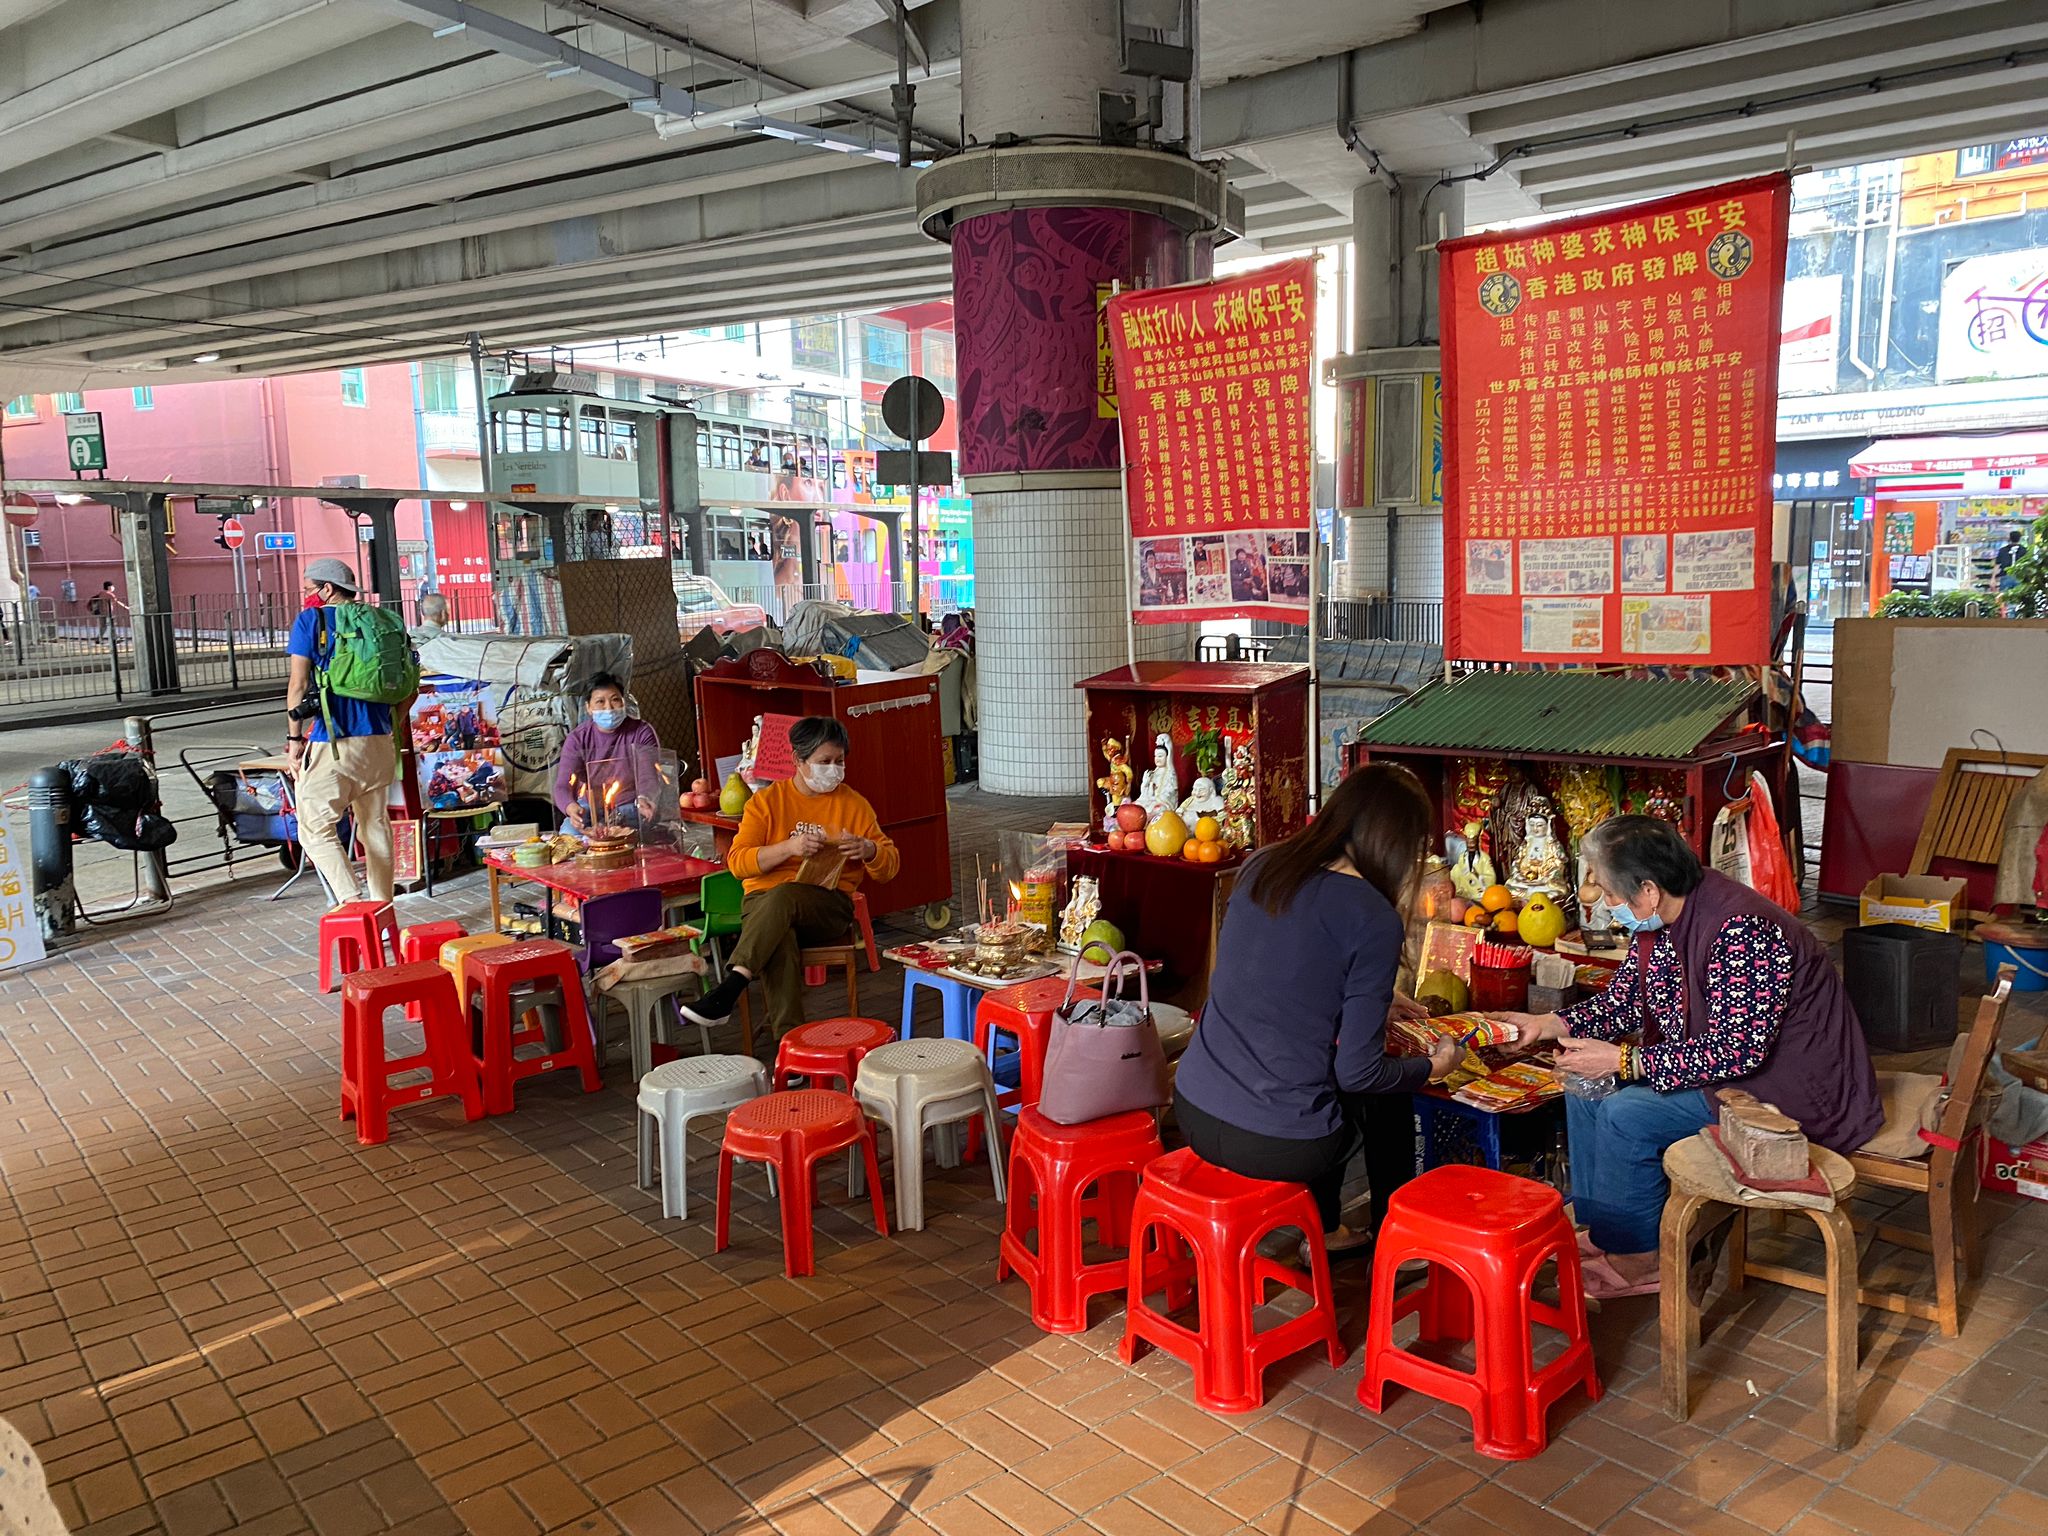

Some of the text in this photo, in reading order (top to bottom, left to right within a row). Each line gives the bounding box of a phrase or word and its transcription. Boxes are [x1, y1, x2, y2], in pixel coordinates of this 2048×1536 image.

[1475, 200, 1747, 274] 趙姑神婆求神保平安
[1526, 251, 1699, 300] 香港政府發牌
[1213, 279, 1306, 336] 求神保平安
[1977, 314, 2006, 345] 招
[1150, 374, 1299, 411] 香港政府發牌
